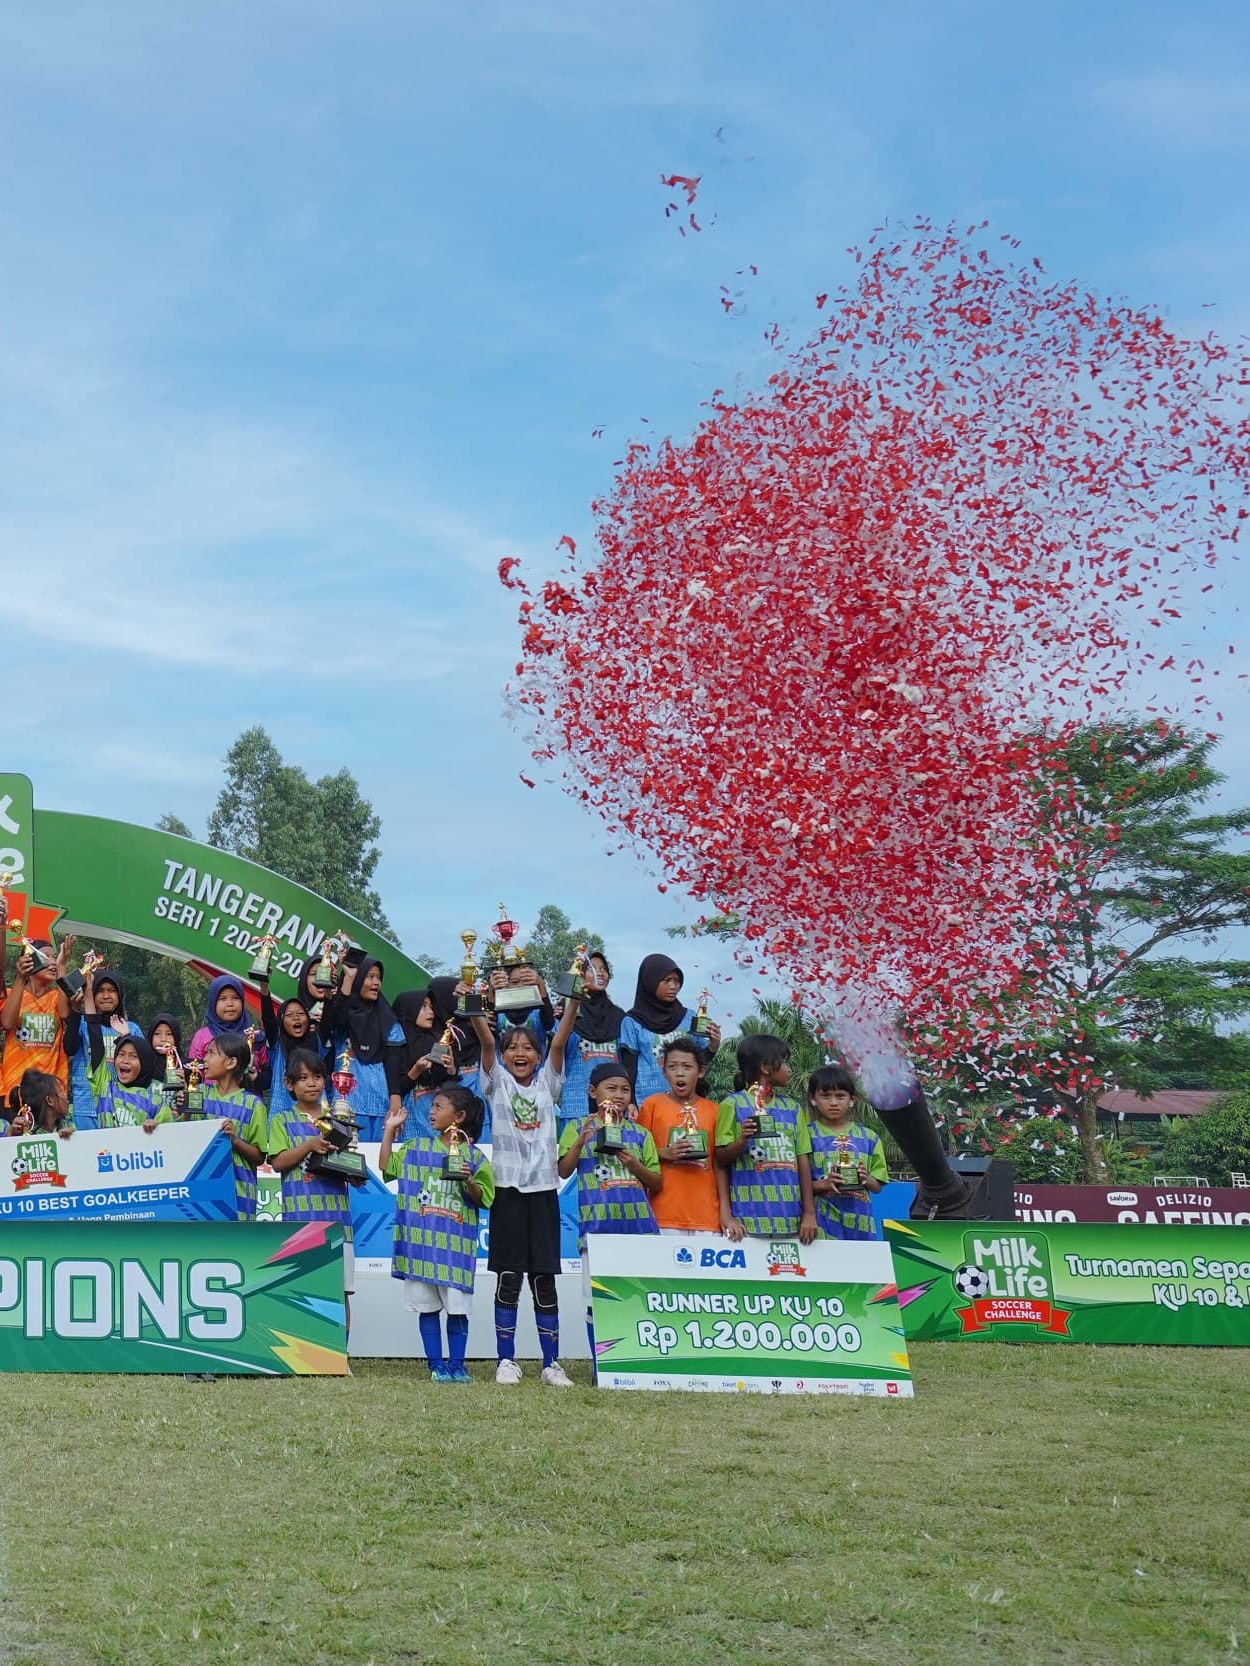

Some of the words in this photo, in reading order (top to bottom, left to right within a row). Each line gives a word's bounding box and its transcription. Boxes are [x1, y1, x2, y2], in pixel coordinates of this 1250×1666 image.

[154, 897, 204, 930] SERI
[210, 917, 220, 937] 1
[222, 924, 303, 980] 202-20
[26, 1015, 55, 1028] Milk
[30, 1028, 55, 1042] Life
[22, 1143, 54, 1159] Milk
[766, 1145, 796, 1162] Life
[28, 1156, 56, 1173] Life
[116, 1150, 164, 1172] blibli
[17, 1199, 34, 1213] 10
[39, 1196, 79, 1211] BEST
[83, 1187, 190, 1206] GOALKEEPER
[431, 1191, 461, 1212] Life
[1109, 1194, 1136, 1202] SAVORIA
[1155, 1193, 1212, 1207] DELIZIO
[104, 1211, 155, 1222] Pembinaan
[773, 1244, 796, 1254] Milk
[973, 1238, 1042, 1268] Milk
[700, 1248, 746, 1268] BCA
[777, 1254, 799, 1265] Life
[1065, 1254, 1188, 1277] Turnamen
[988, 1267, 1048, 1297] Life
[991, 1300, 1032, 1310] SOCCER
[1152, 1284, 1188, 1311] KU
[1193, 1289, 1218, 1306] 10
[1224, 1284, 1244, 1308] &
[647, 1292, 739, 1315] RUNNER
[743, 1295, 775, 1315] UP
[780, 1296, 812, 1321] KU
[816, 1297, 844, 1317] 10
[984, 1310, 1042, 1320] CHALLENGE
[637, 1320, 678, 1355] Rp
[684, 1319, 862, 1352] 1.200.000
